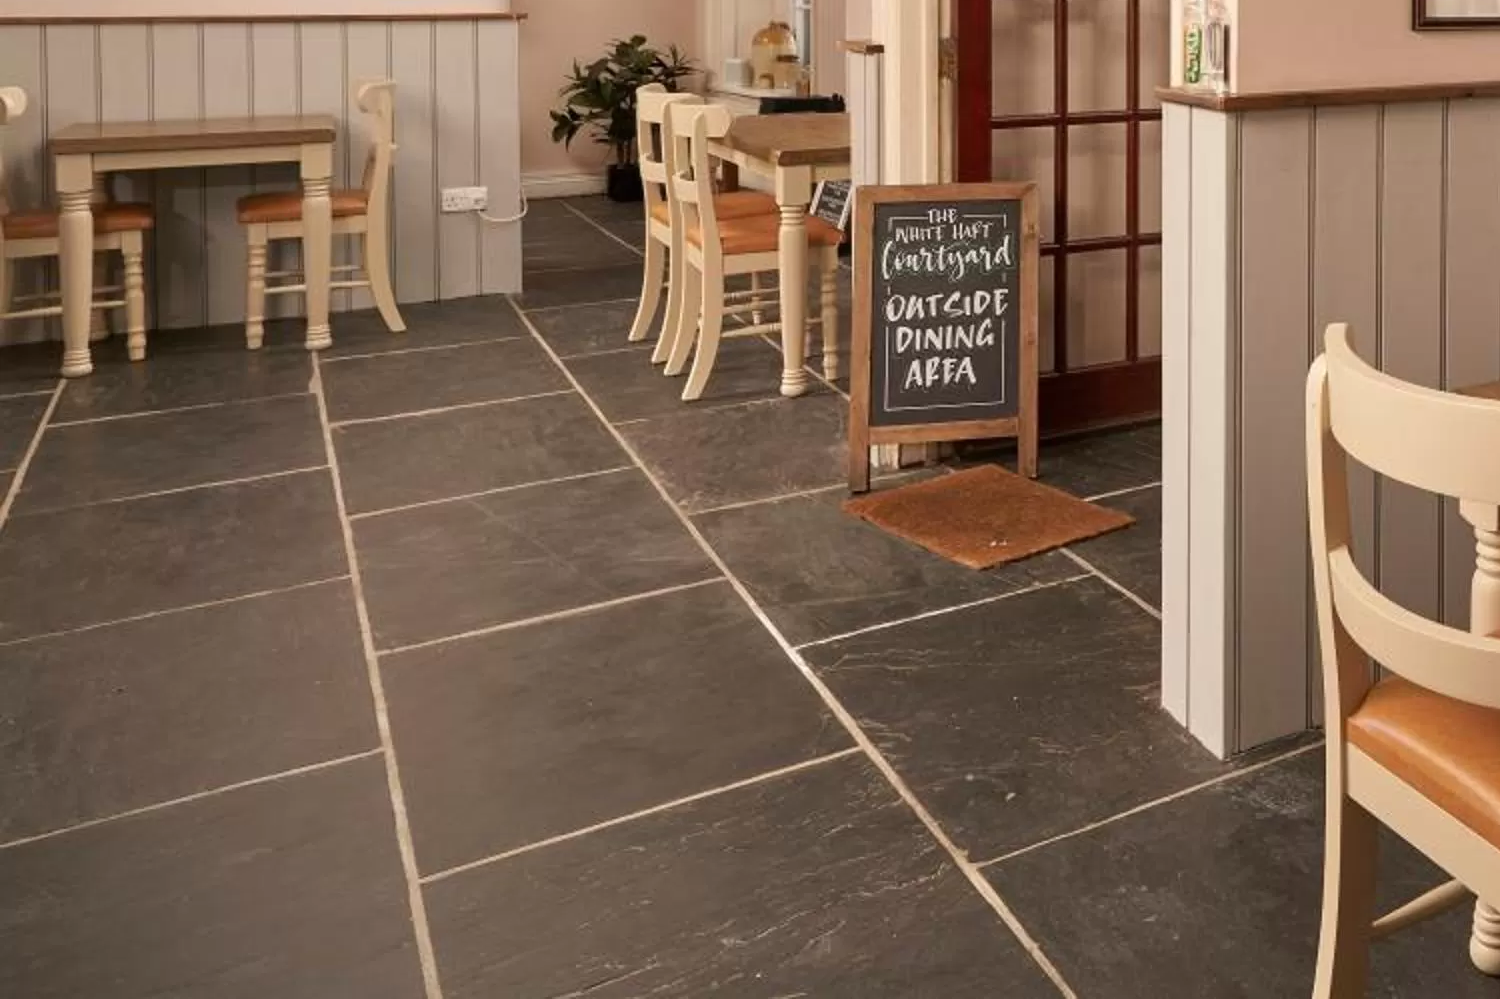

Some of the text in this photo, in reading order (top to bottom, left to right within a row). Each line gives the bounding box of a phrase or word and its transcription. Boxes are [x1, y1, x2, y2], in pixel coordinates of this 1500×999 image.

[928, 208, 957, 224] THE
[881, 234, 1011, 282] Courtyard
[885, 288, 1009, 322] OUTSIDE
[895, 318, 996, 354] DINING
[904, 356, 977, 390] AREA
